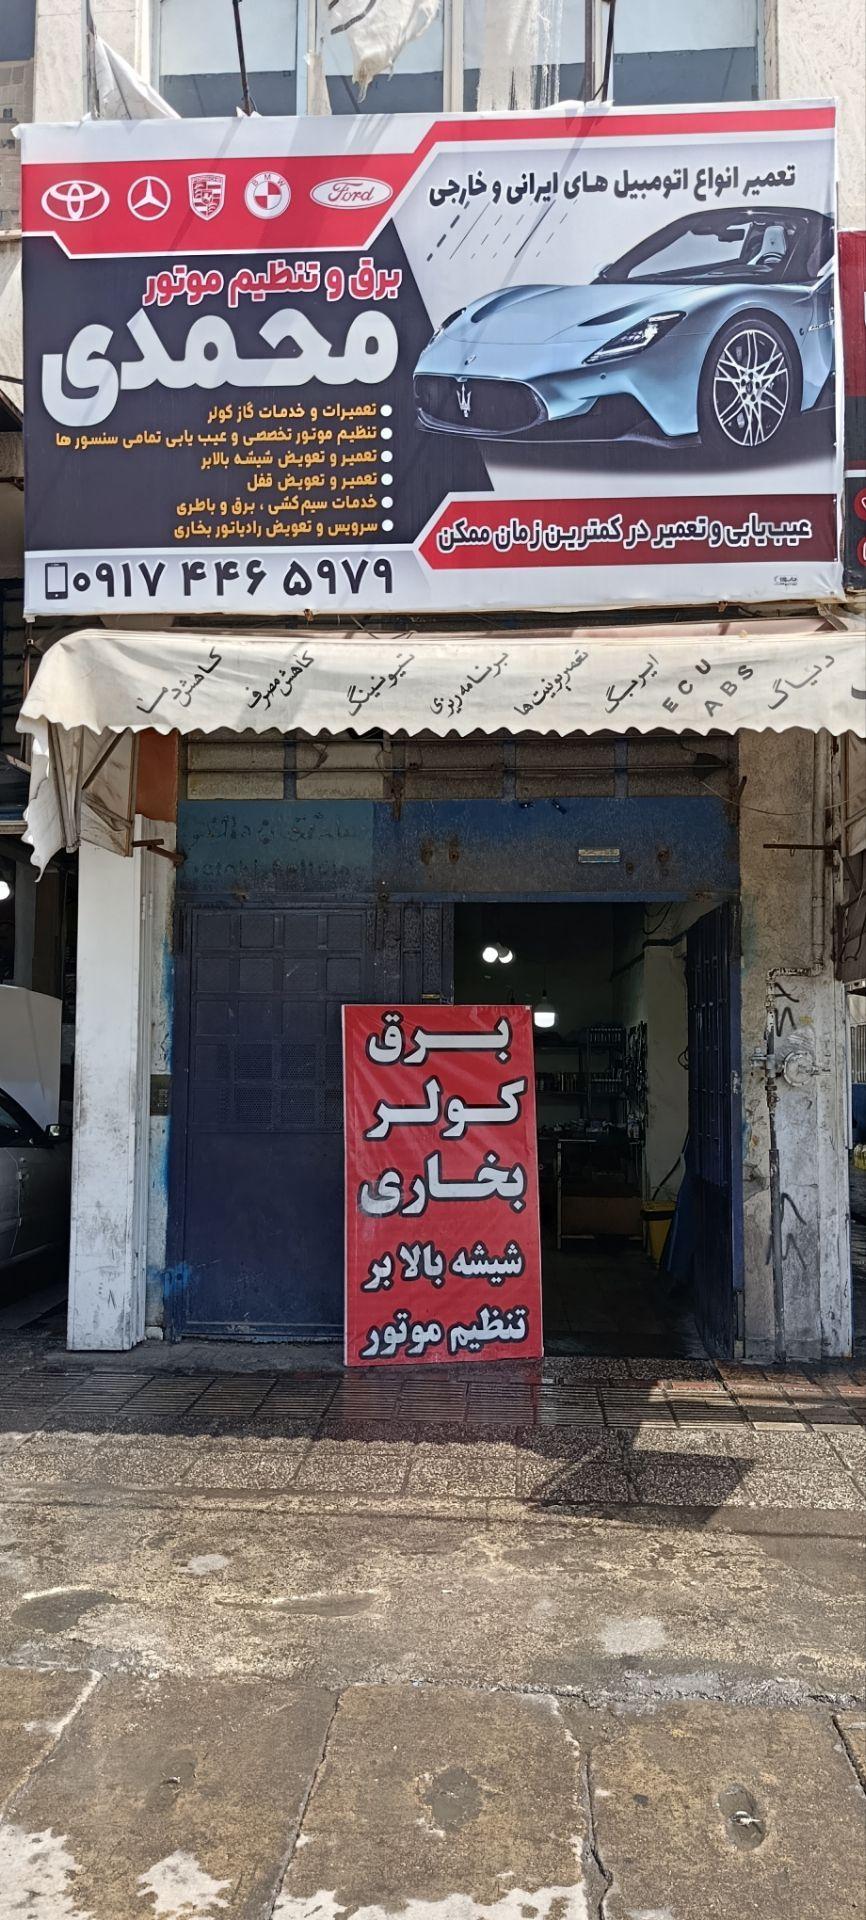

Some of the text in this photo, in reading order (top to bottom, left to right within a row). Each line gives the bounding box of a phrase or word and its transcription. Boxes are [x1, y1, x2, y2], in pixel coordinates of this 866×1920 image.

[252, 174, 286, 187] BMW
[327, 181, 375, 203] Ford
[429, 164, 796, 207] تعمیر انواع اتومبیل های ایرانی و خارجی
[142, 257, 402, 308] برق و تنظیم موتور
[41, 308, 400, 427] محمدی
[207, 401, 377, 424] تعمیرات و خدمات گاز کولر
[55, 425, 377, 450] تنظیم موتور تخصصی و عیب یابی تمامی سنسور ها
[200, 450, 378, 470] تعمیر و تعویض شیشه بالابر
[246, 473, 378, 492] تعمیر و تعویض قفل
[176, 498, 216, 517] باطری
[219, 501, 228, 515] و
[231, 497, 256, 515] برق
[332, 494, 378, 509] خدمات
[173, 519, 379, 540] سرویس و تعویض رادیاتور بخاری
[436, 517, 493, 553] ممکن
[495, 517, 542, 551] زمان
[544, 514, 622, 551] کمترین
[623, 520, 652, 549] در
[651, 515, 708, 549] تعمیر
[708, 521, 723, 547] و
[72, 557, 394, 598] ۰۹۱۷ ۴۴۶ ۵۹۷۹
[245, 650, 314, 711] کاهش مصرف
[347, 653, 416, 716] تیونینگ
[430, 652, 509, 718] برنامه ریزی
[604, 653, 660, 714] ایربگ
[662, 658, 712, 713] ECU
[704, 664, 754, 718] ABS
[767, 655, 835, 710] دیاگ
[366, 1011, 513, 1066] برق
[362, 1073, 530, 1141] کولر
[356, 1150, 526, 1218] بخاری
[360, 1241, 526, 1292] شیشه بالا بر
[360, 1303, 530, 1359] تنظیم موتور
